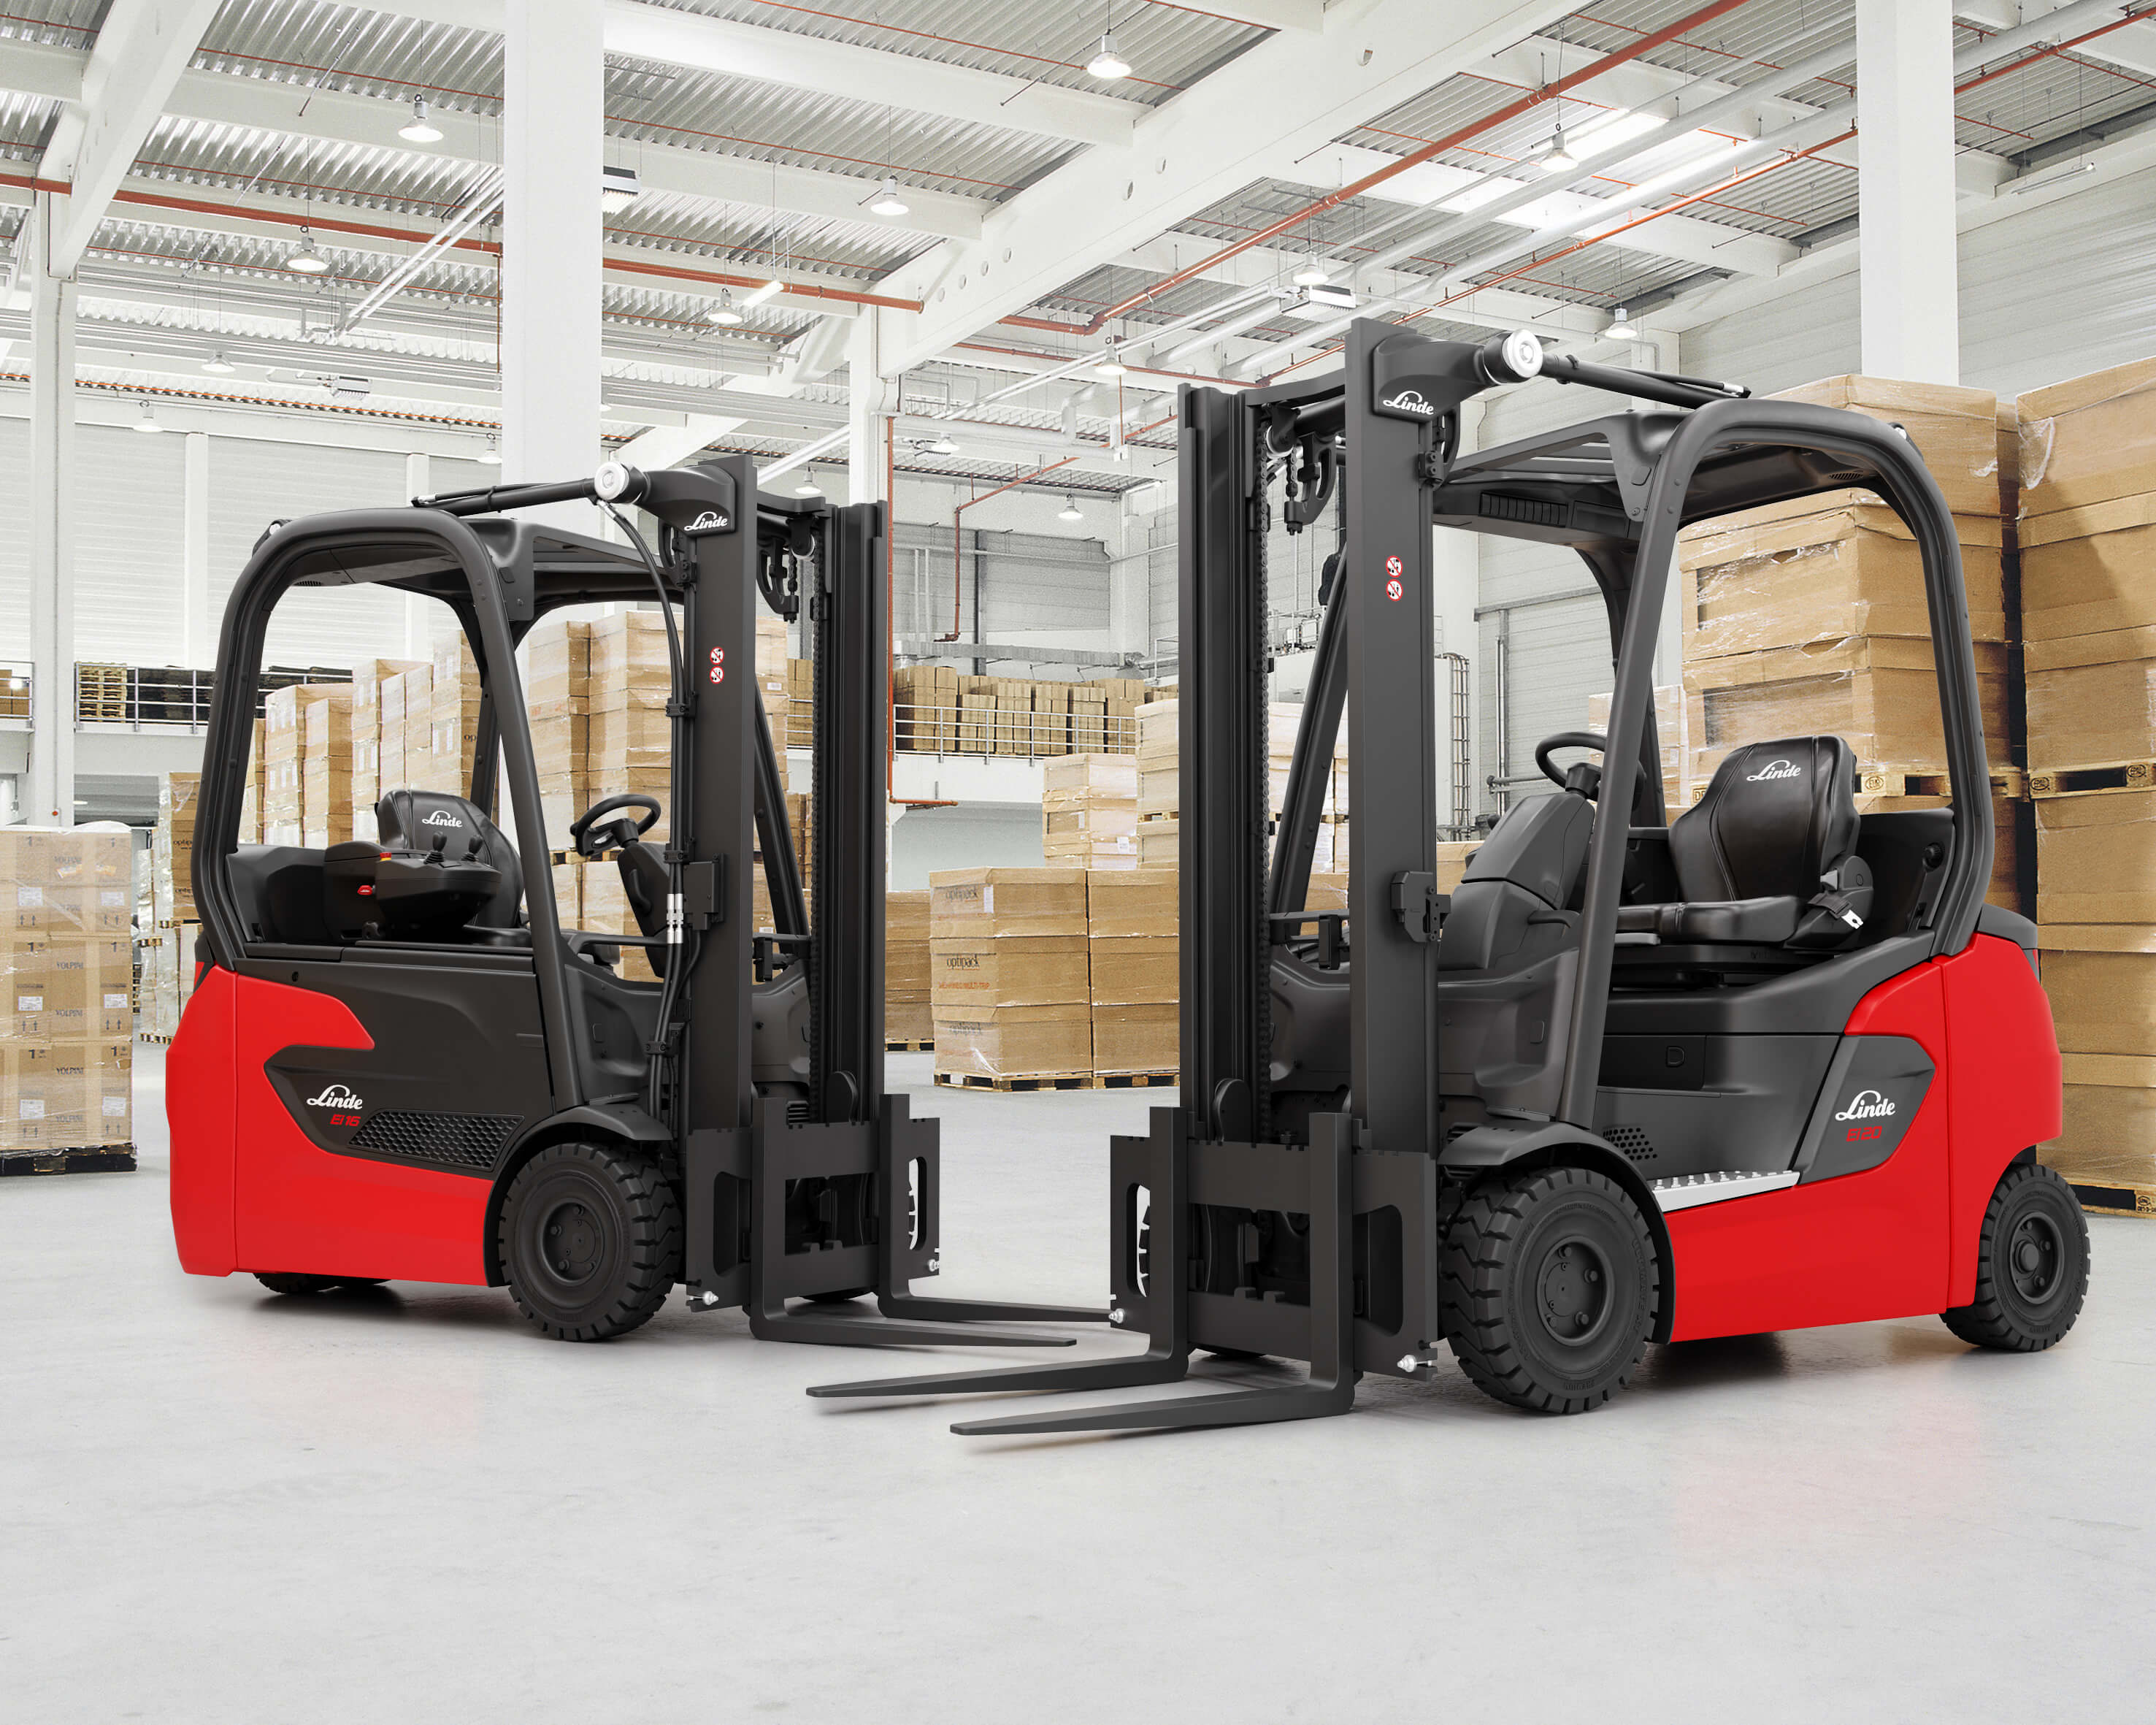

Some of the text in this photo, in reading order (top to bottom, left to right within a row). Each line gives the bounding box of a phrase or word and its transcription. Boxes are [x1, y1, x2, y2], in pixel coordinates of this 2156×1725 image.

[1382, 390, 1434, 415] Linde
[683, 511, 728, 531] Linde
[1746, 760, 1801, 781] Linde
[421, 810, 463, 827] Linde
[946, 955, 980, 970] optipack
[28, 1049, 35, 1059] 1
[111, 1047, 118, 1057] 1
[307, 1085, 363, 1109] Linde
[1835, 1090, 1896, 1121] Linde
